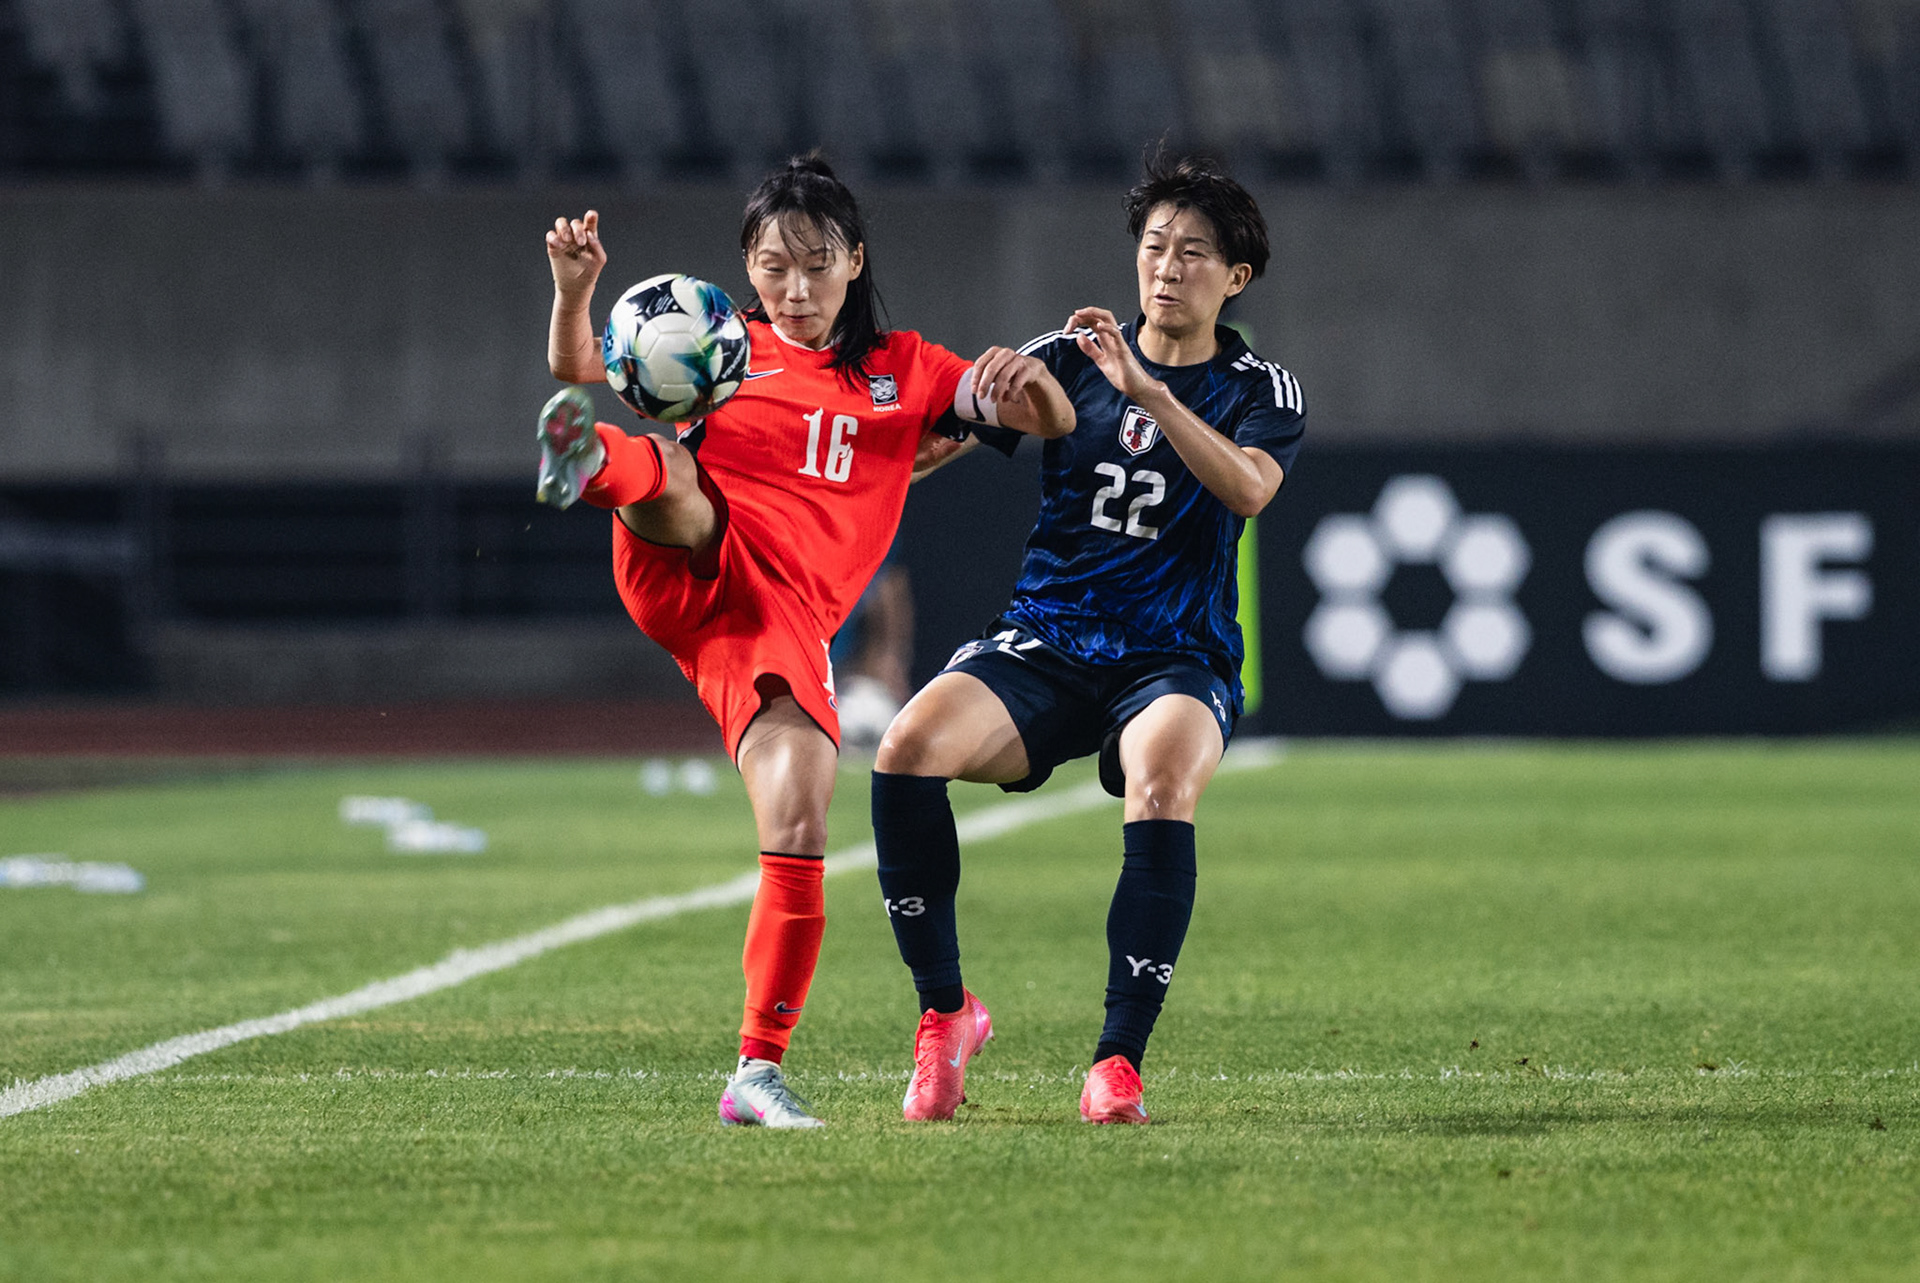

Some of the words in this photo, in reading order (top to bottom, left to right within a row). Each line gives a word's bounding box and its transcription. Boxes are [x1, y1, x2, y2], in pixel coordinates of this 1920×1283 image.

[873, 403, 902, 412] KOREA
[797, 407, 859, 483] 16
[1090, 462, 1166, 540] 22
[1125, 954, 1174, 985] Y-3
